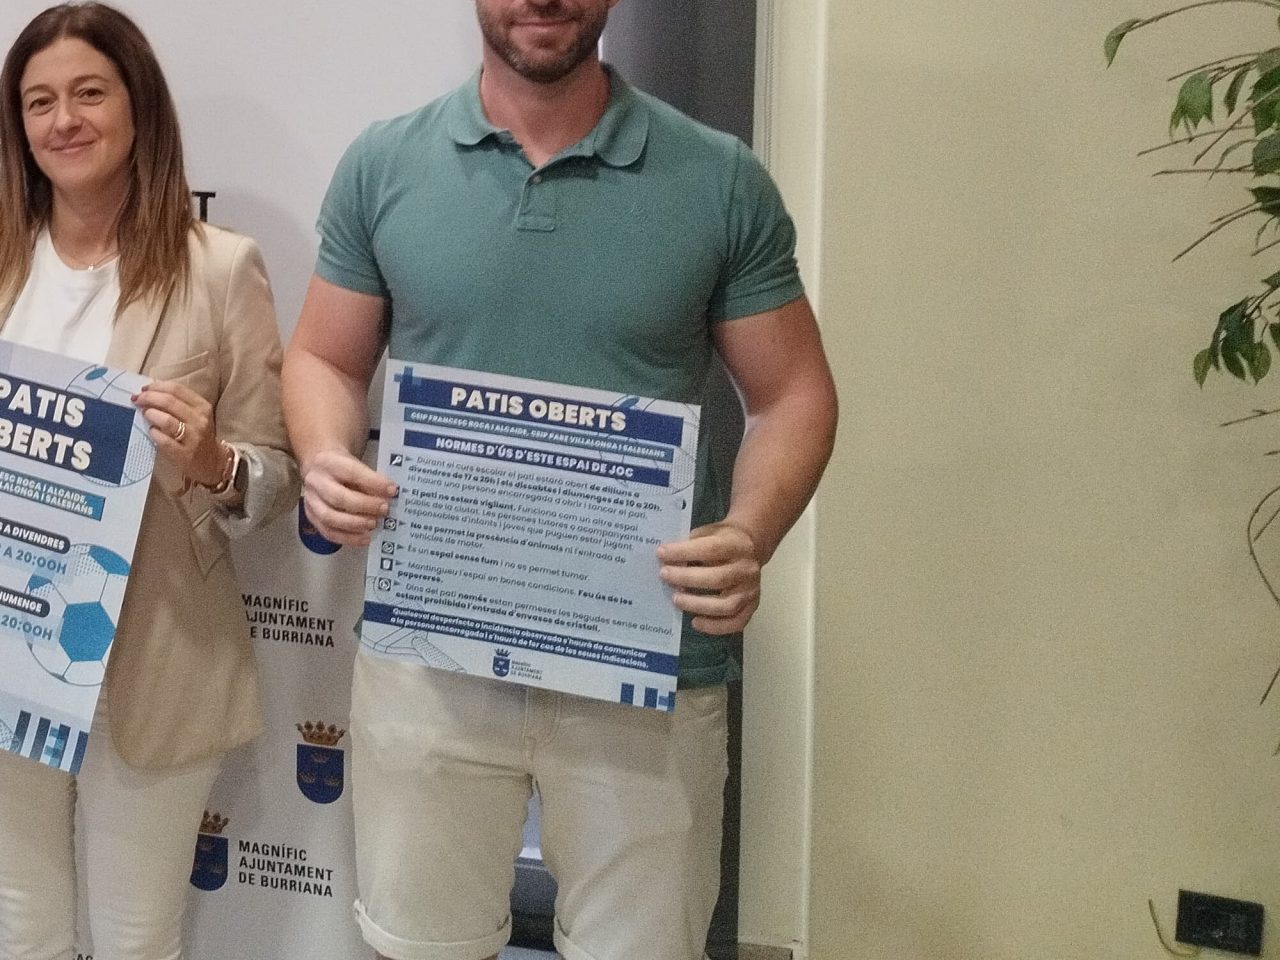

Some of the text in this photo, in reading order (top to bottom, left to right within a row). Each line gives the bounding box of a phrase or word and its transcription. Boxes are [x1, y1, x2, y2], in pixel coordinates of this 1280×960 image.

[450, 387, 627, 432] PATIS OBERTS
[435, 436, 484, 454] NORMES
[555, 455, 589, 470] ESPAI
[591, 461, 607, 473] DE
[608, 463, 634, 477] JOC
[11, 527, 64, 550] DIVENDRES
[263, 627, 335, 648] BURRIANA
[239, 840, 308, 861] MAGNÍFIC
[240, 856, 334, 881] AJUNTAMENT
[239, 871, 333, 898] DE BURRIANA
